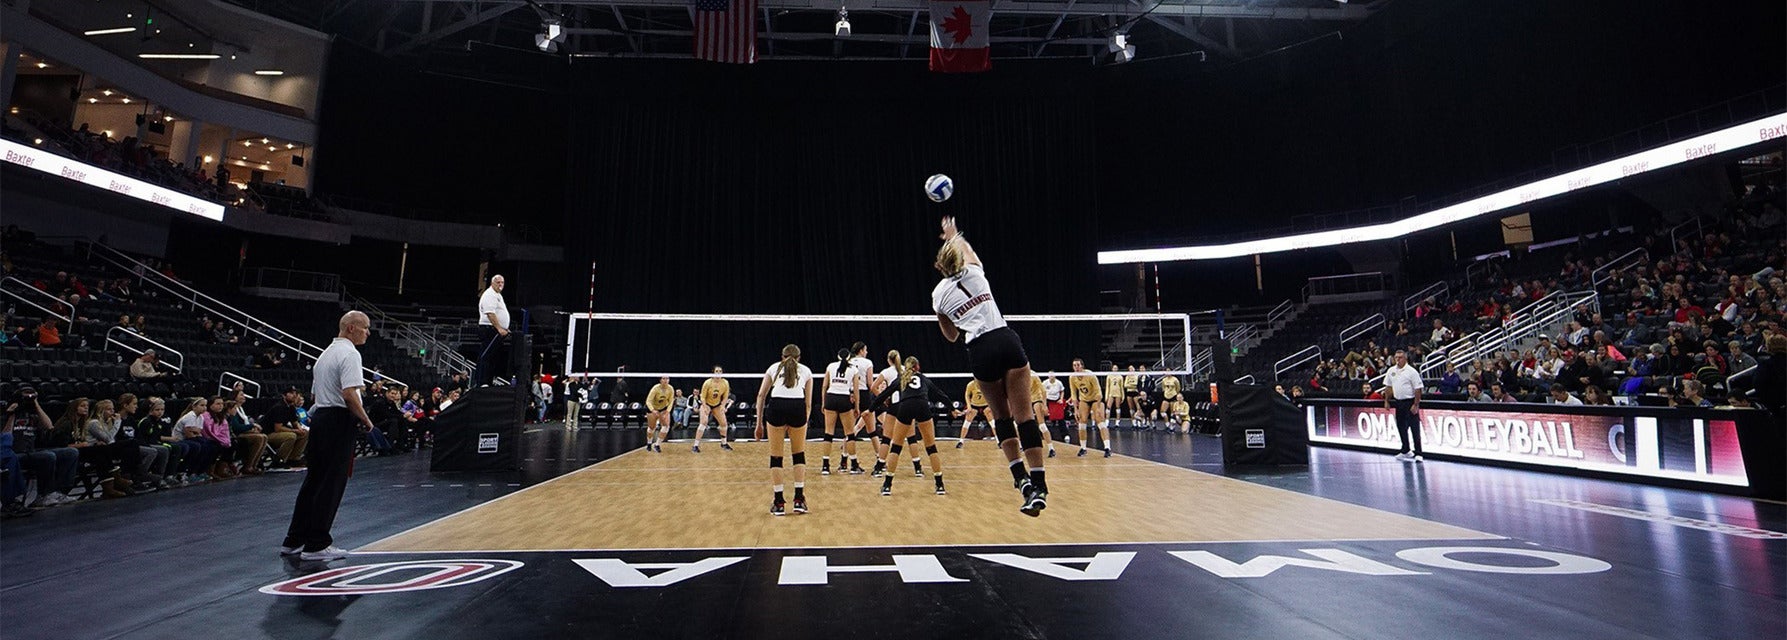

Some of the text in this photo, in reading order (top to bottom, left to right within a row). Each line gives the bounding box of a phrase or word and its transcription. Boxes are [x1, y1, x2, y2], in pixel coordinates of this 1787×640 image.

[1760, 124, 1787, 140] Baxt
[5, 150, 35, 166] Baxter
[1685, 143, 1716, 159] Baxter
[61, 166, 86, 180] Baxter
[1622, 162, 1648, 175] Baxter
[109, 180, 132, 194] Baxter
[909, 375, 921, 389] 3
[1357, 412, 1584, 459] OMA VOLLEYBALL
[571, 546, 1611, 588] OMAHA
